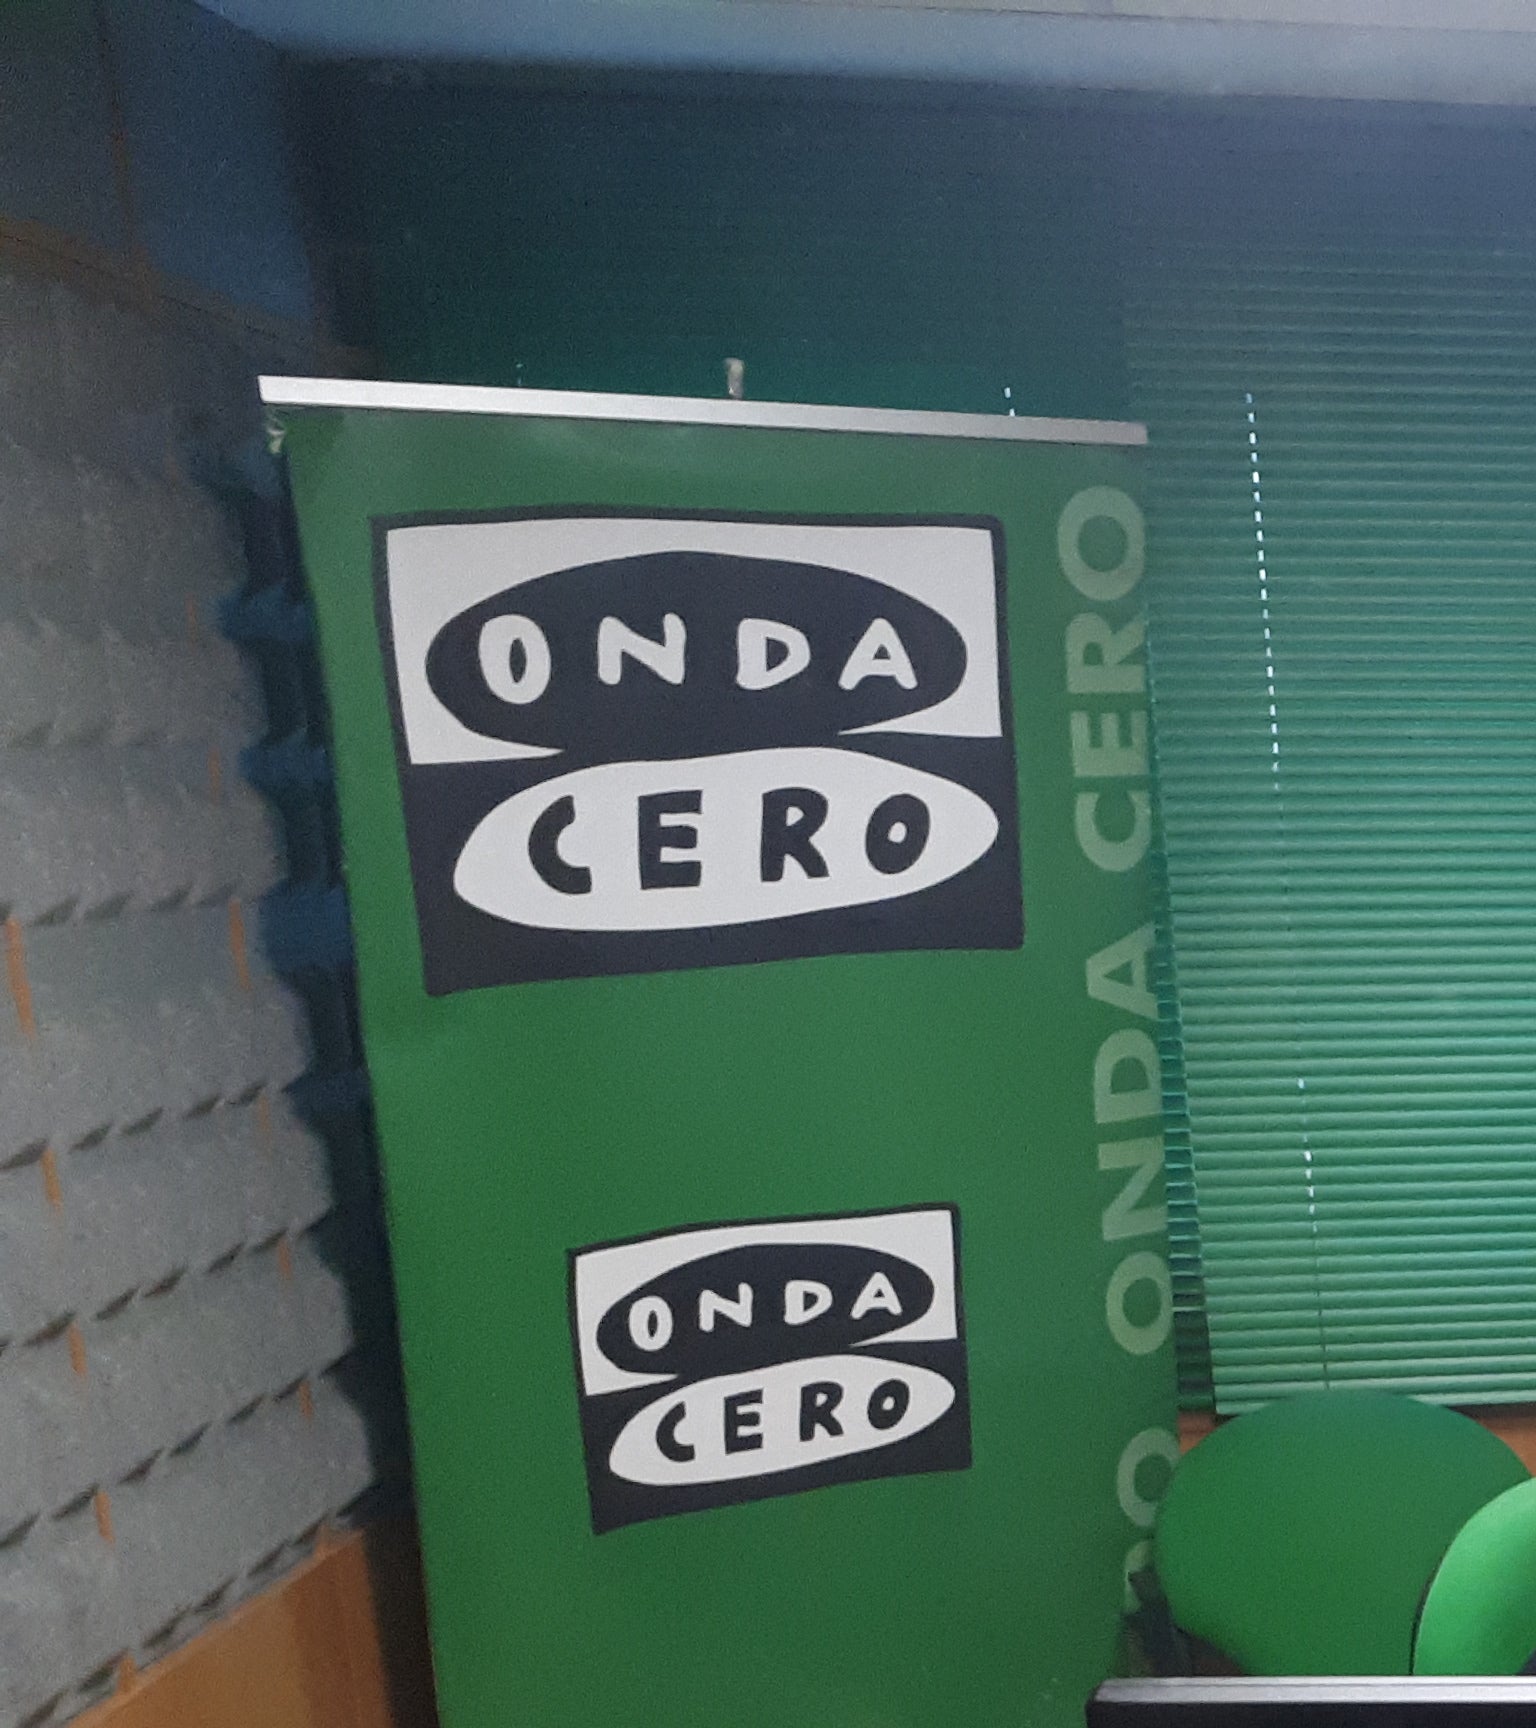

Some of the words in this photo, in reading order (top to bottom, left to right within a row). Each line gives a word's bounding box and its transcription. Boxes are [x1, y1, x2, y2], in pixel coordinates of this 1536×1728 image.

[477, 612, 918, 705] ONDA
[1057, 485, 1153, 873] CERO
[527, 786, 931, 895] CERO
[1086, 920, 1173, 1356] ONDA
[628, 1271, 903, 1352] ONDA
[655, 1378, 910, 1463] CERO
